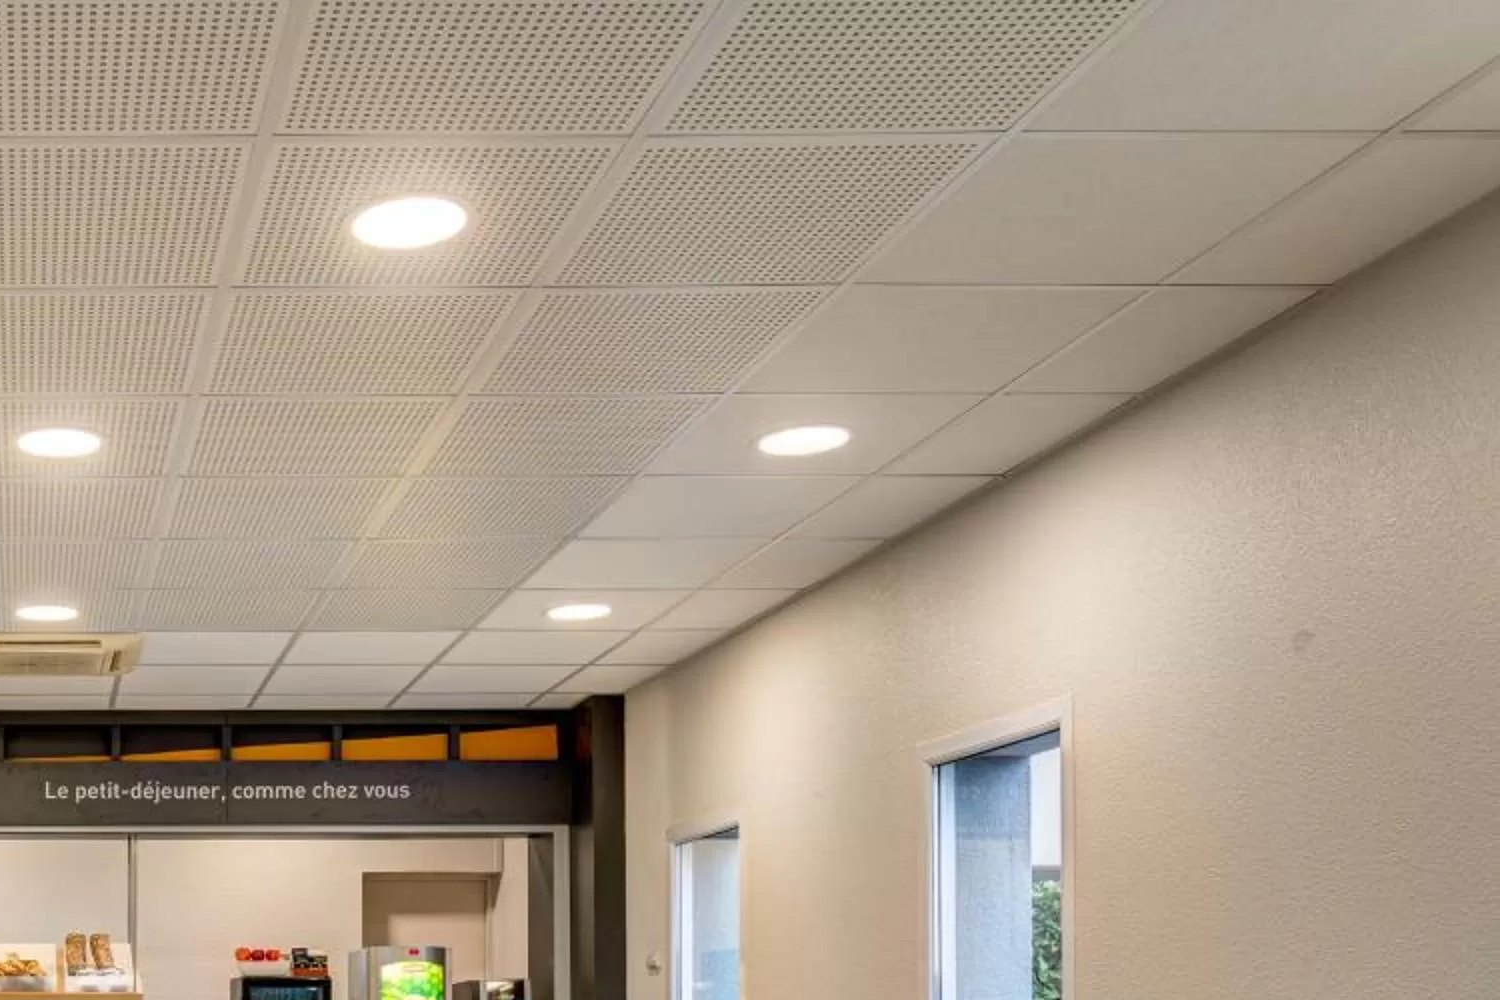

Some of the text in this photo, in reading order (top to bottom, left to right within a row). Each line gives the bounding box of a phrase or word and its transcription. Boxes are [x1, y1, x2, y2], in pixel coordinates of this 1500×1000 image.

[44, 781, 411, 804] Le petit-déjeuner, comme chez vous
